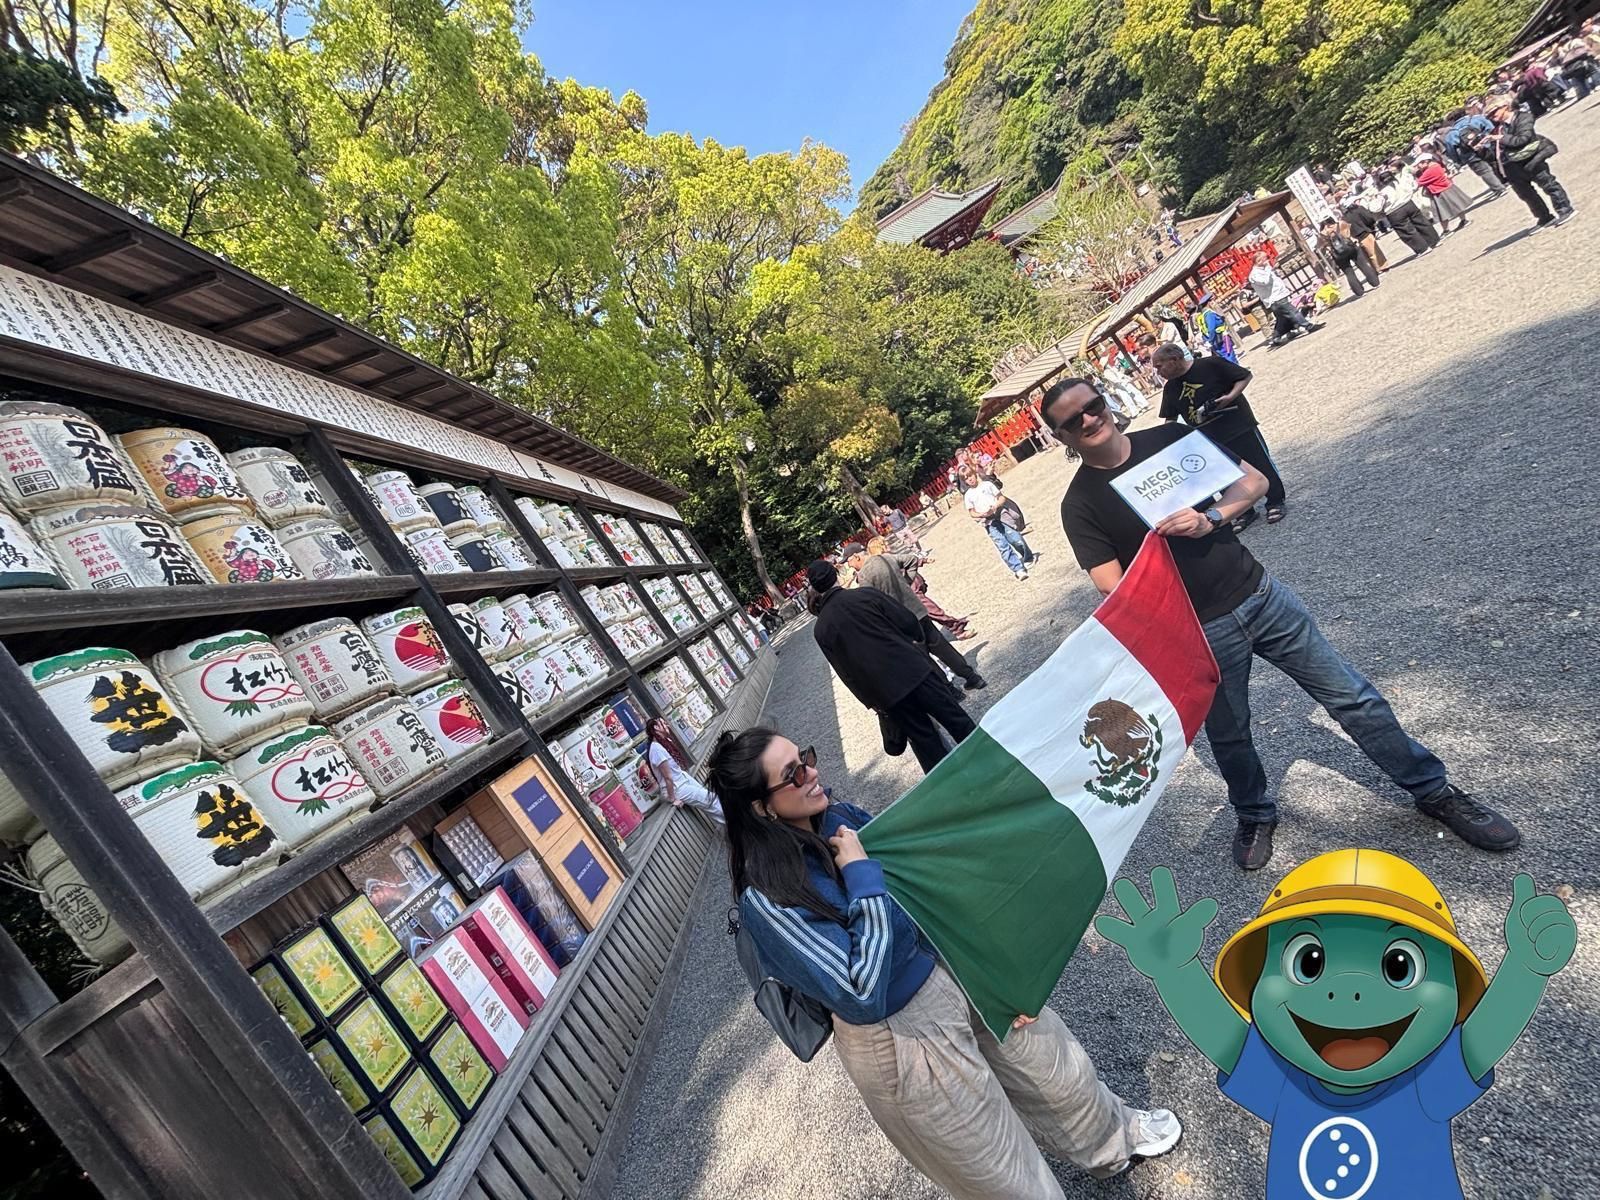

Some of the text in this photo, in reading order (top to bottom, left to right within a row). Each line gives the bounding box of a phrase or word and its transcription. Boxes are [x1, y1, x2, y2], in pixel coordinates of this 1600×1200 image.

[62, 419, 138, 495] 日本盛
[1134, 465, 1181, 496] MEGA
[1142, 474, 1189, 502] TRAVEL
